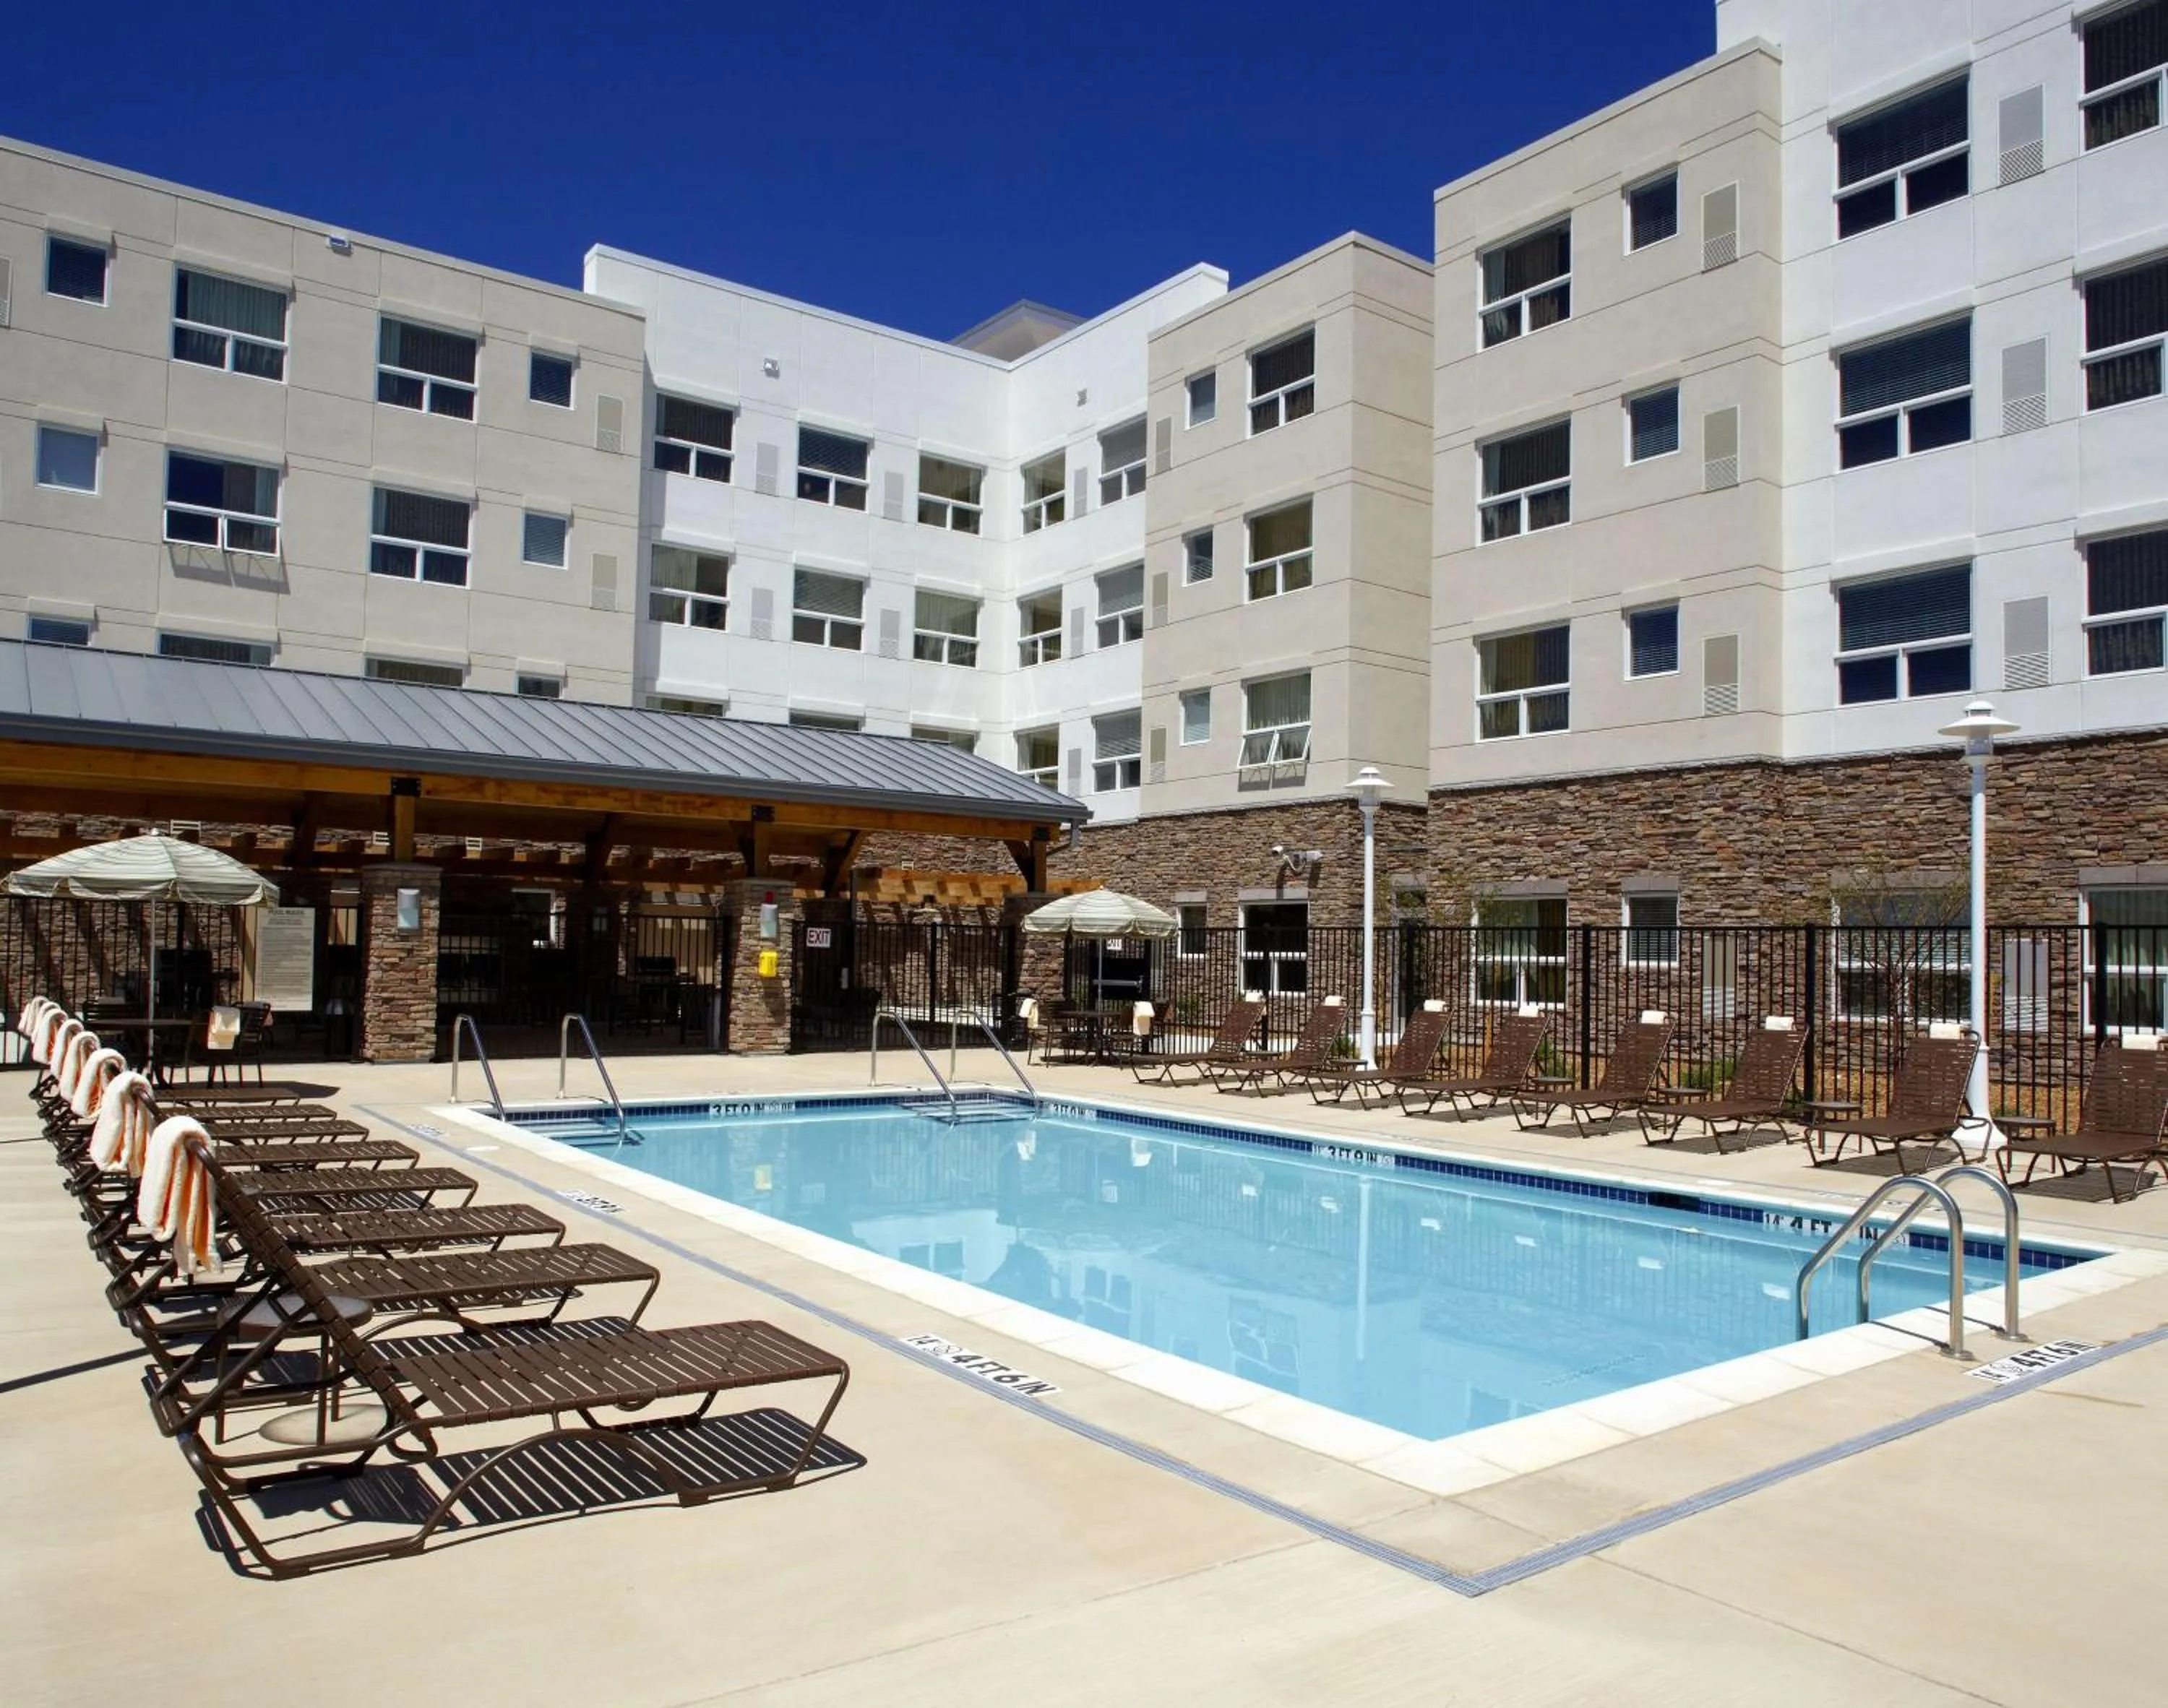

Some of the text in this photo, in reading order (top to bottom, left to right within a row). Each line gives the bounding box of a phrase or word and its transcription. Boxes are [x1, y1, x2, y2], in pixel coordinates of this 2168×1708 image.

[809, 930, 830, 944] EXIT
[1811, 1218, 1832, 1233] FT
[1859, 1225, 1878, 1240] IN
[2020, 1350, 2065, 1363] FT
[2043, 1345, 2079, 1355] 6
[951, 1355, 984, 1363] 4
[2009, 1356, 2047, 1368] 4
[965, 1360, 1012, 1376] FT
[992, 1374, 1028, 1384] 6
[1011, 1381, 1057, 1395] IN
